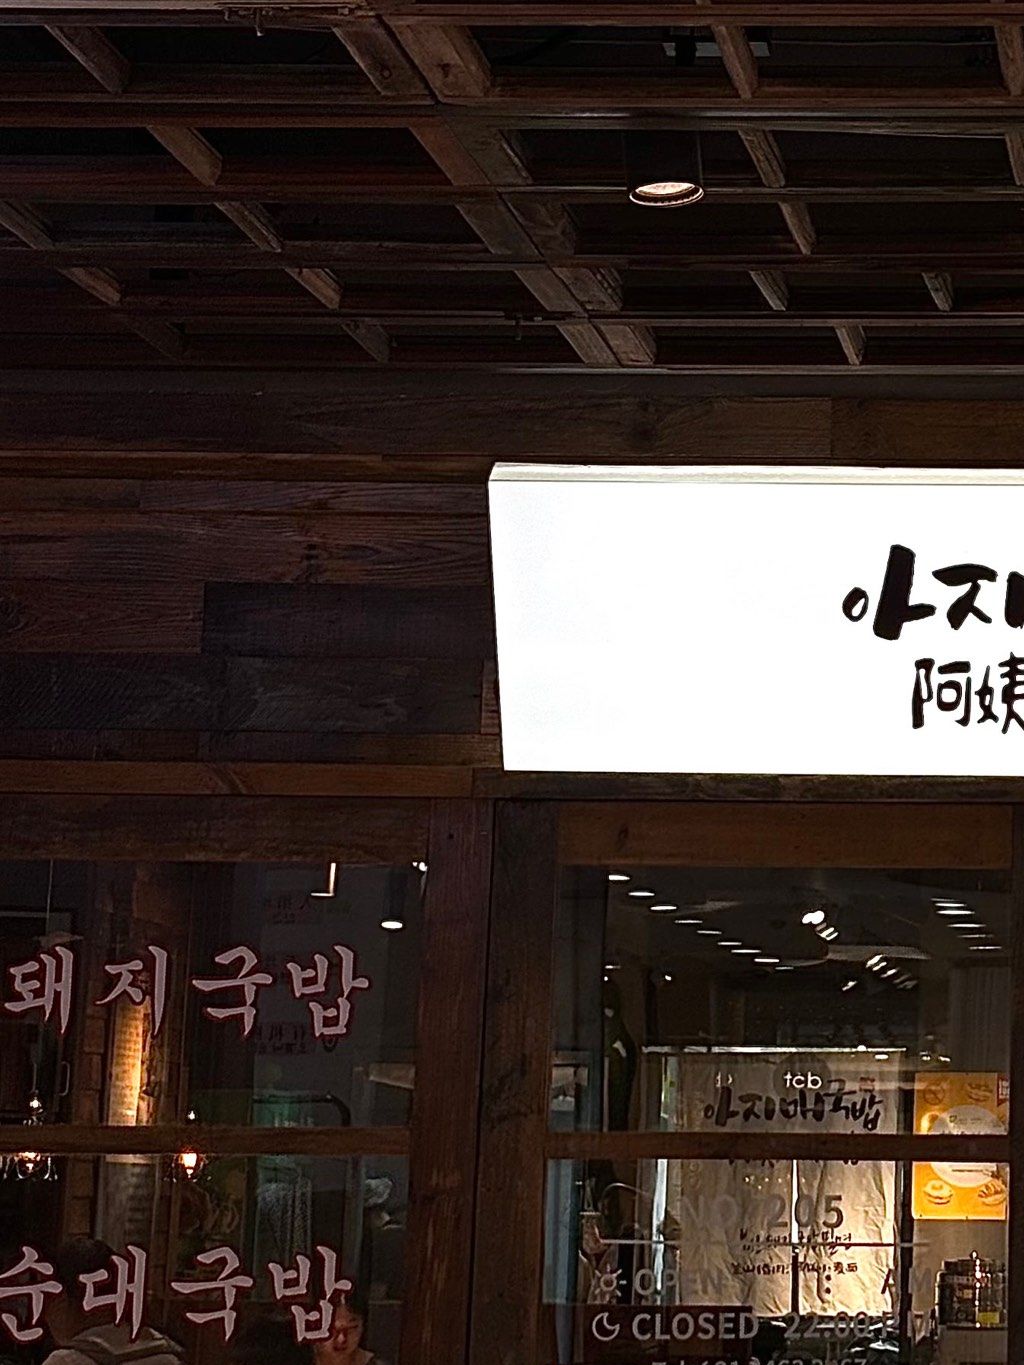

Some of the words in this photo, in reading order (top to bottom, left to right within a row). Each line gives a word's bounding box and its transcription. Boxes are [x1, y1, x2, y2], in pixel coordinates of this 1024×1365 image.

[4, 945, 369, 1037] 돼지국밥
[0, 1245, 353, 1342] 순대국밥
[631, 1312, 760, 1341] CLOSED
